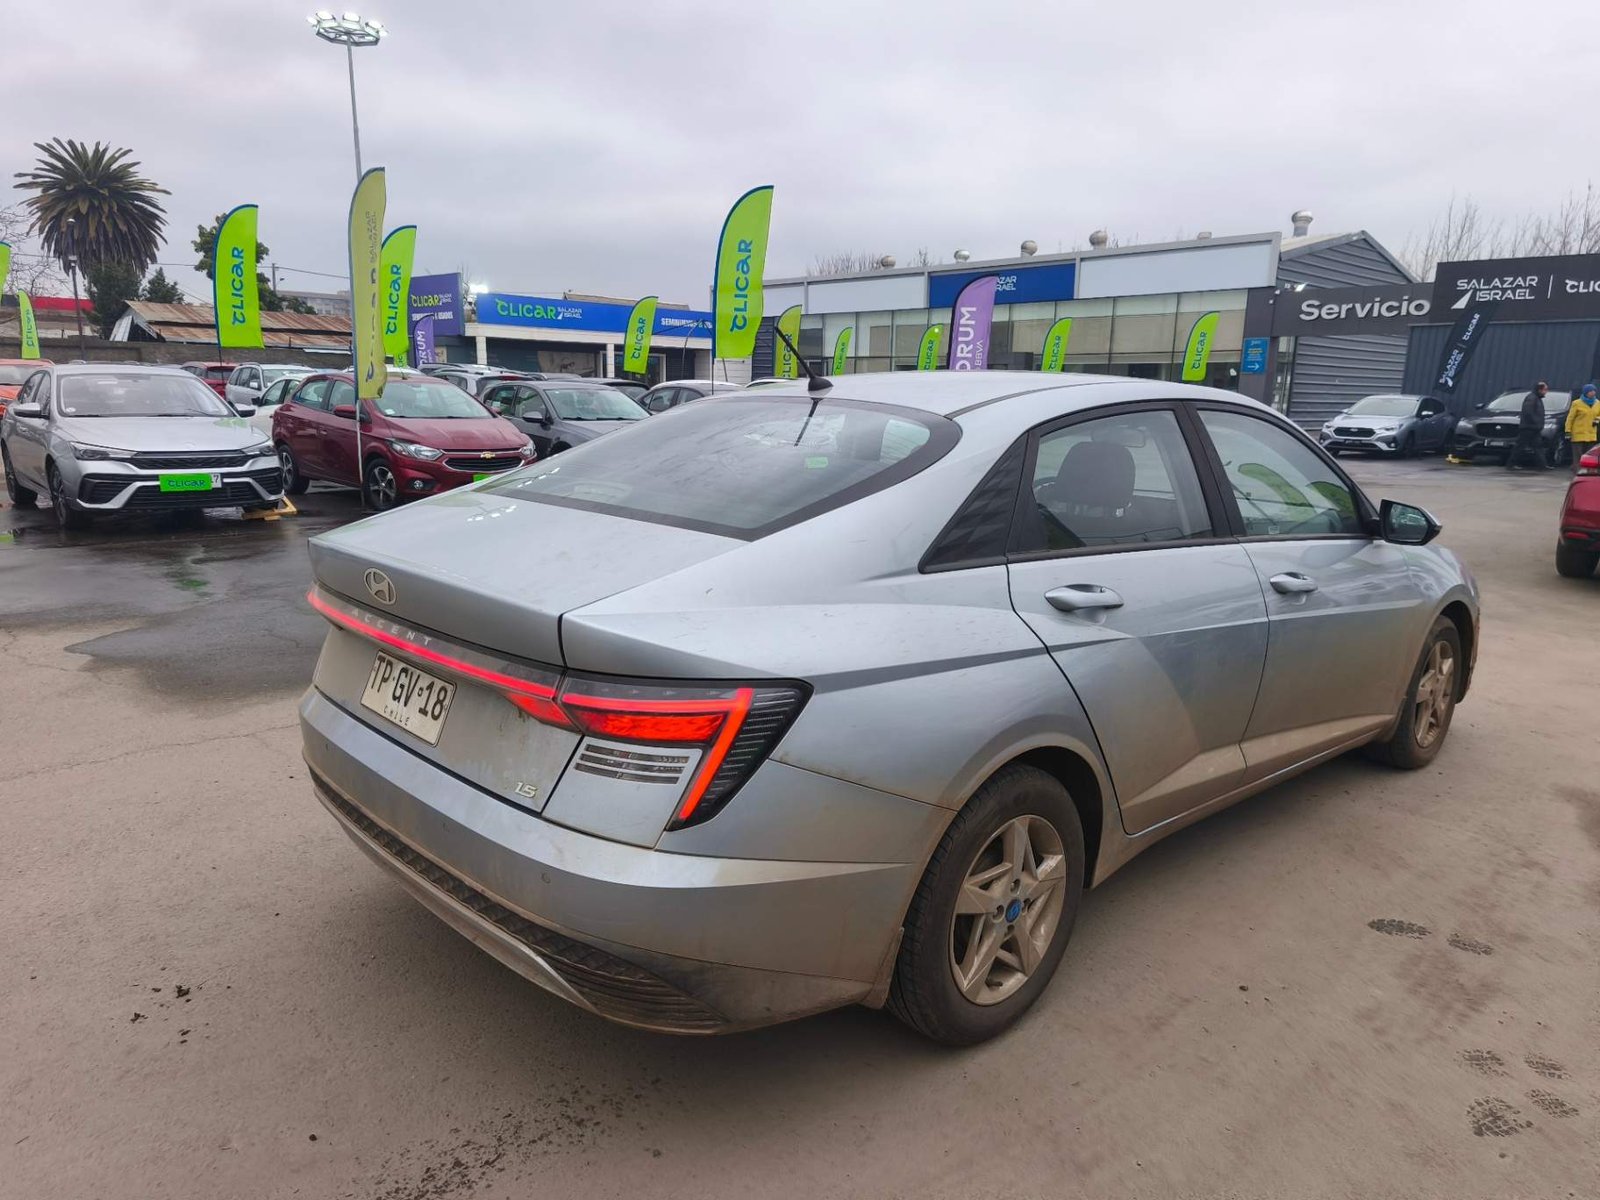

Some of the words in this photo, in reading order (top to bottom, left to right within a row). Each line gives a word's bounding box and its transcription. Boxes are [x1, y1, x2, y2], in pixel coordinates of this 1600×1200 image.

[1456, 276, 1538, 290] SALAZAR
[1476, 289, 1535, 301] ISRAEL
[1299, 295, 1431, 321] Servicio
[956, 306, 977, 370] ORUM
[975, 340, 983, 366] BBVA
[351, 607, 432, 646] ACCENT
[384, 705, 410, 726] CHILE
